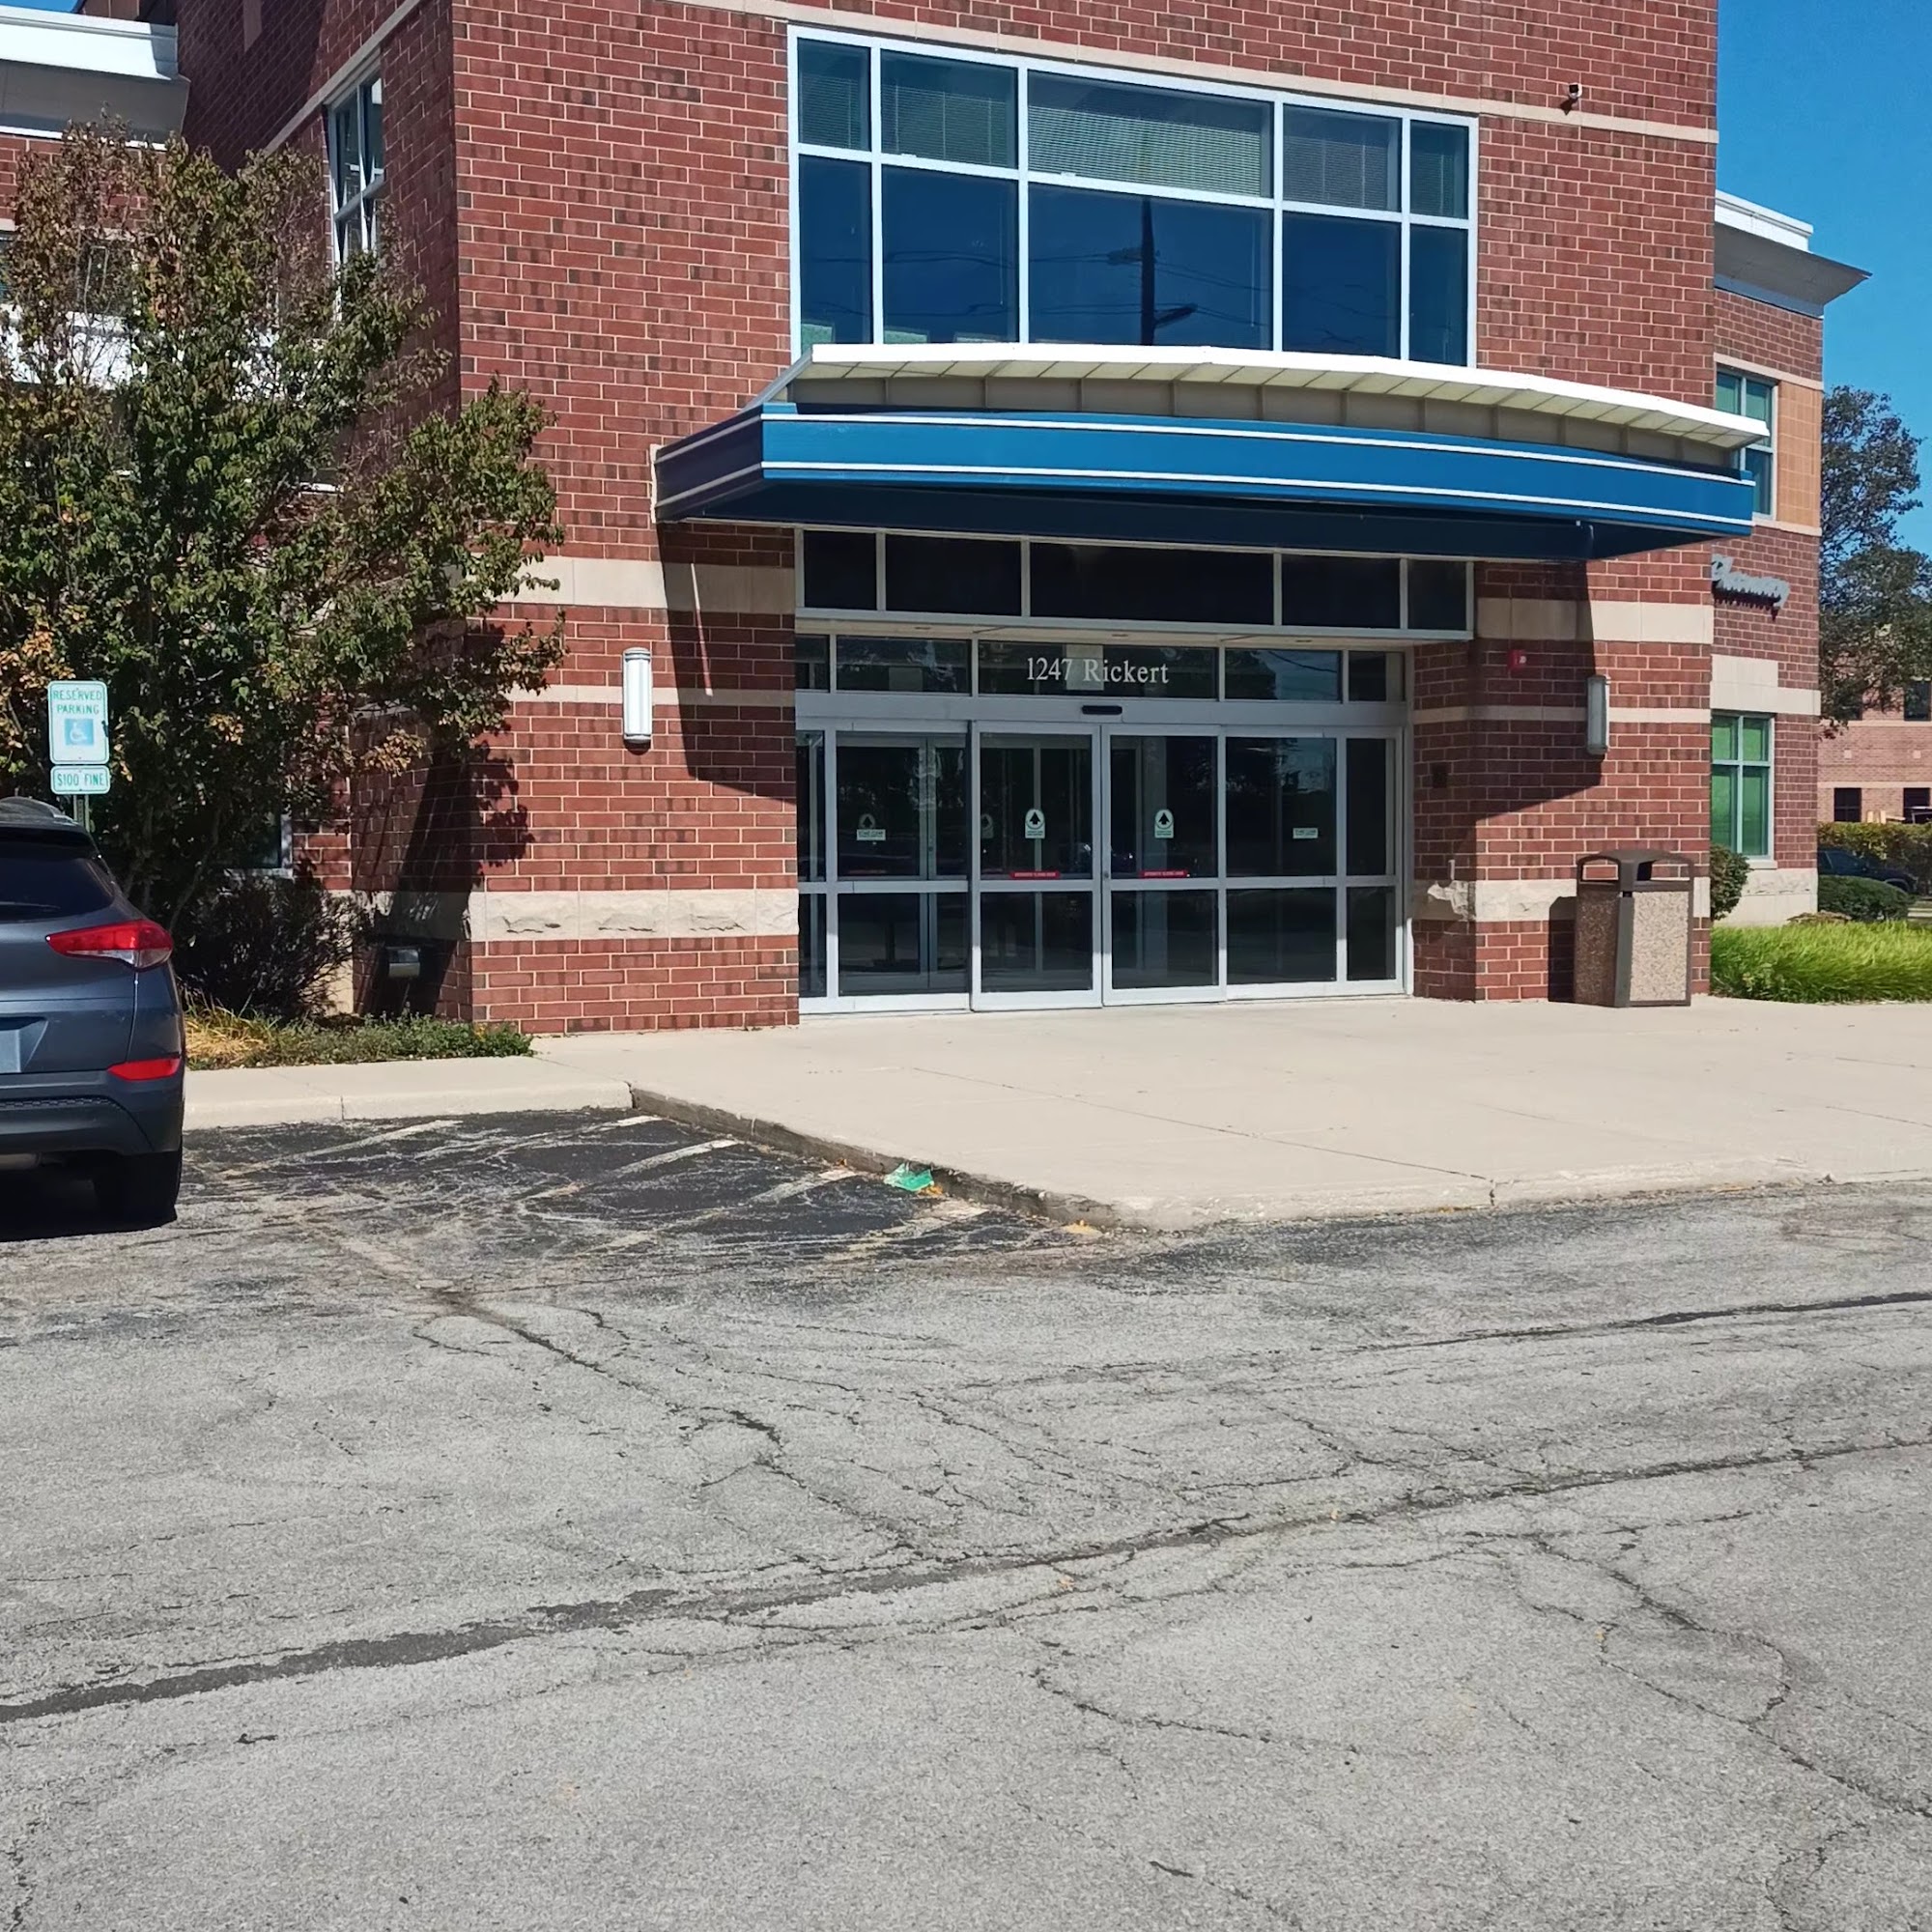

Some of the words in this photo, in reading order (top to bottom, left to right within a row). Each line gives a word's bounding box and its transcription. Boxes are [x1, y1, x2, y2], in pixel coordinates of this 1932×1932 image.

[1027, 657, 1072, 681] 1247
[1083, 658, 1170, 684] Rickert
[52, 690, 102, 700] RESERVED
[57, 704, 99, 715] PARKING
[57, 773, 79, 786] $100
[84, 773, 104, 786] FINE
